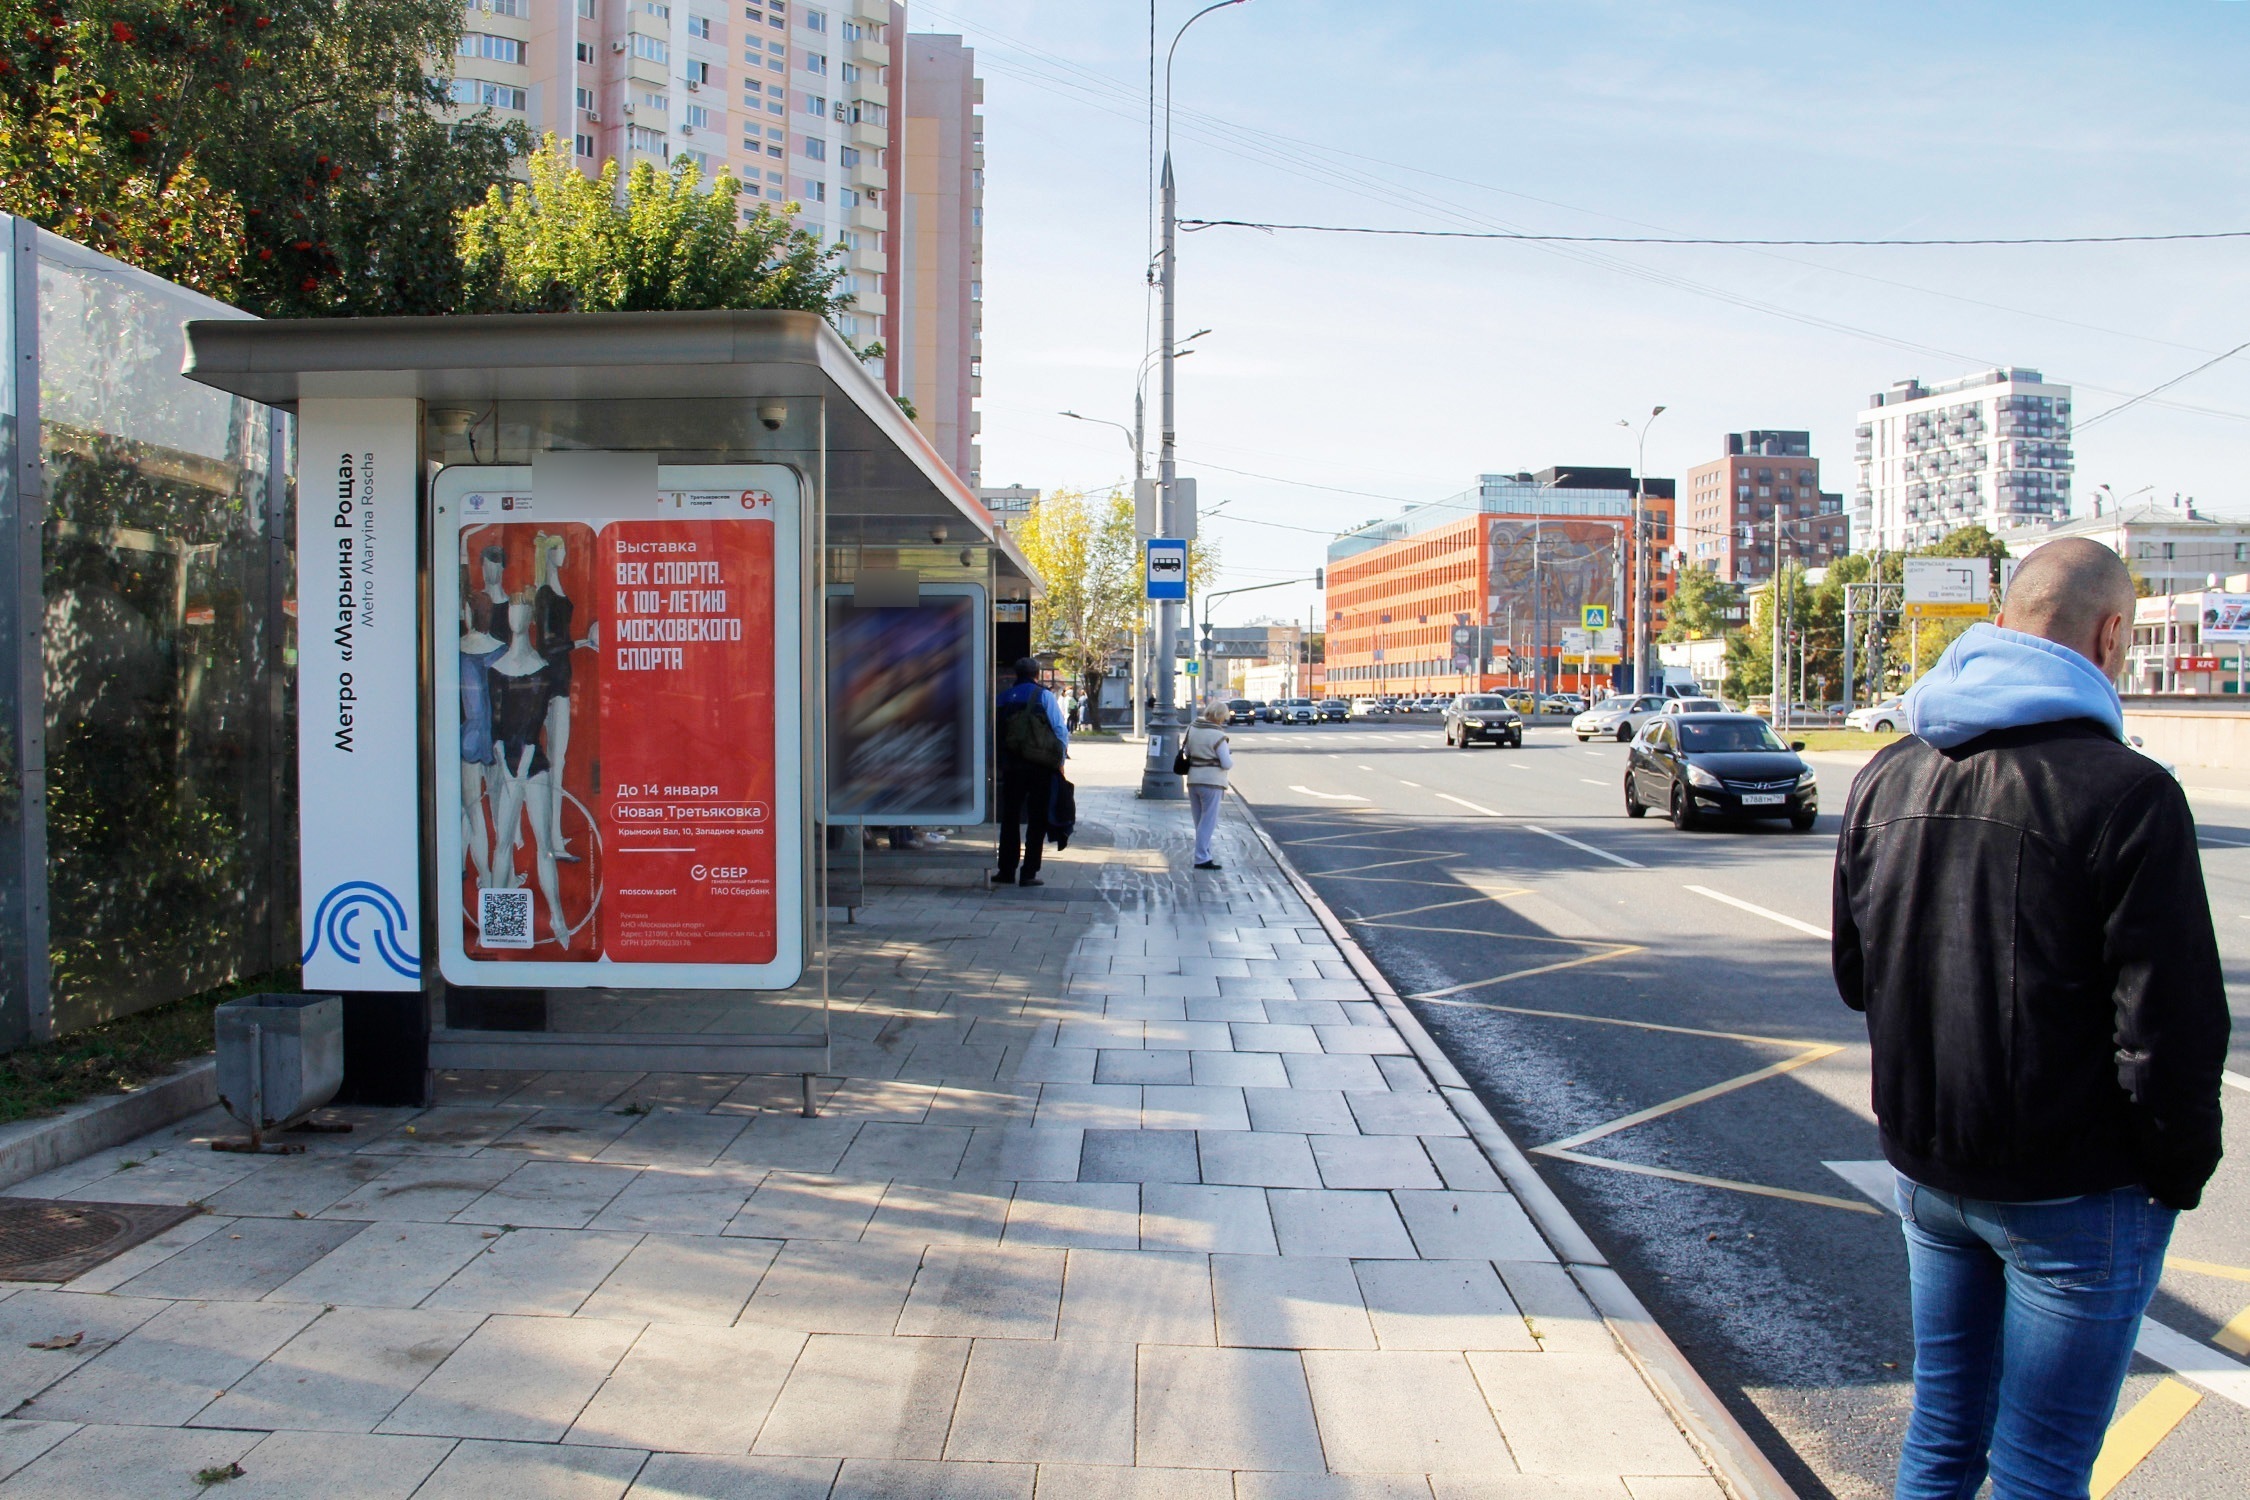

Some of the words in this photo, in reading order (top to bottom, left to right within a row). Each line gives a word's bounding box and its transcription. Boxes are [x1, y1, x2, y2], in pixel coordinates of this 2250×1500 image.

[334, 452, 356, 528] Роща»
[361, 452, 374, 506] Roscha
[740, 490, 772, 509] 6+
[361, 510, 377, 575] Maryina
[616, 540, 697, 553] Выставка
[616, 561, 648, 585] ВЕК
[653, 561, 725, 585] СПОРТА.
[334, 537, 357, 662] «Марьина
[361, 579, 374, 628] Metro
[616, 590, 628, 613] К
[632, 590, 726, 613] 100-ЛЕТИЮ
[616, 618, 741, 642] МОСКОВСКОГО
[617, 647, 683, 671] СПОРТА
[2196, 660, 2214, 668] KFC
[334, 671, 357, 753] Метро
[616, 784, 638, 798] До
[642, 784, 659, 796] 14
[663, 785, 719, 797] января
[617, 806, 663, 818] Новая
[667, 805, 761, 819] Третьяковка
[618, 827, 661, 836] Крымский
[663, 828, 681, 836] Вал,
[682, 828, 693, 836] 10,
[695, 828, 735, 837] Западное
[736, 828, 764, 836] крыло
[710, 867, 748, 878] СБЕР
[619, 888, 677, 896] moscow.sport
[711, 887, 729, 895] ПАО
[730, 887, 770, 896] Сбербанк
